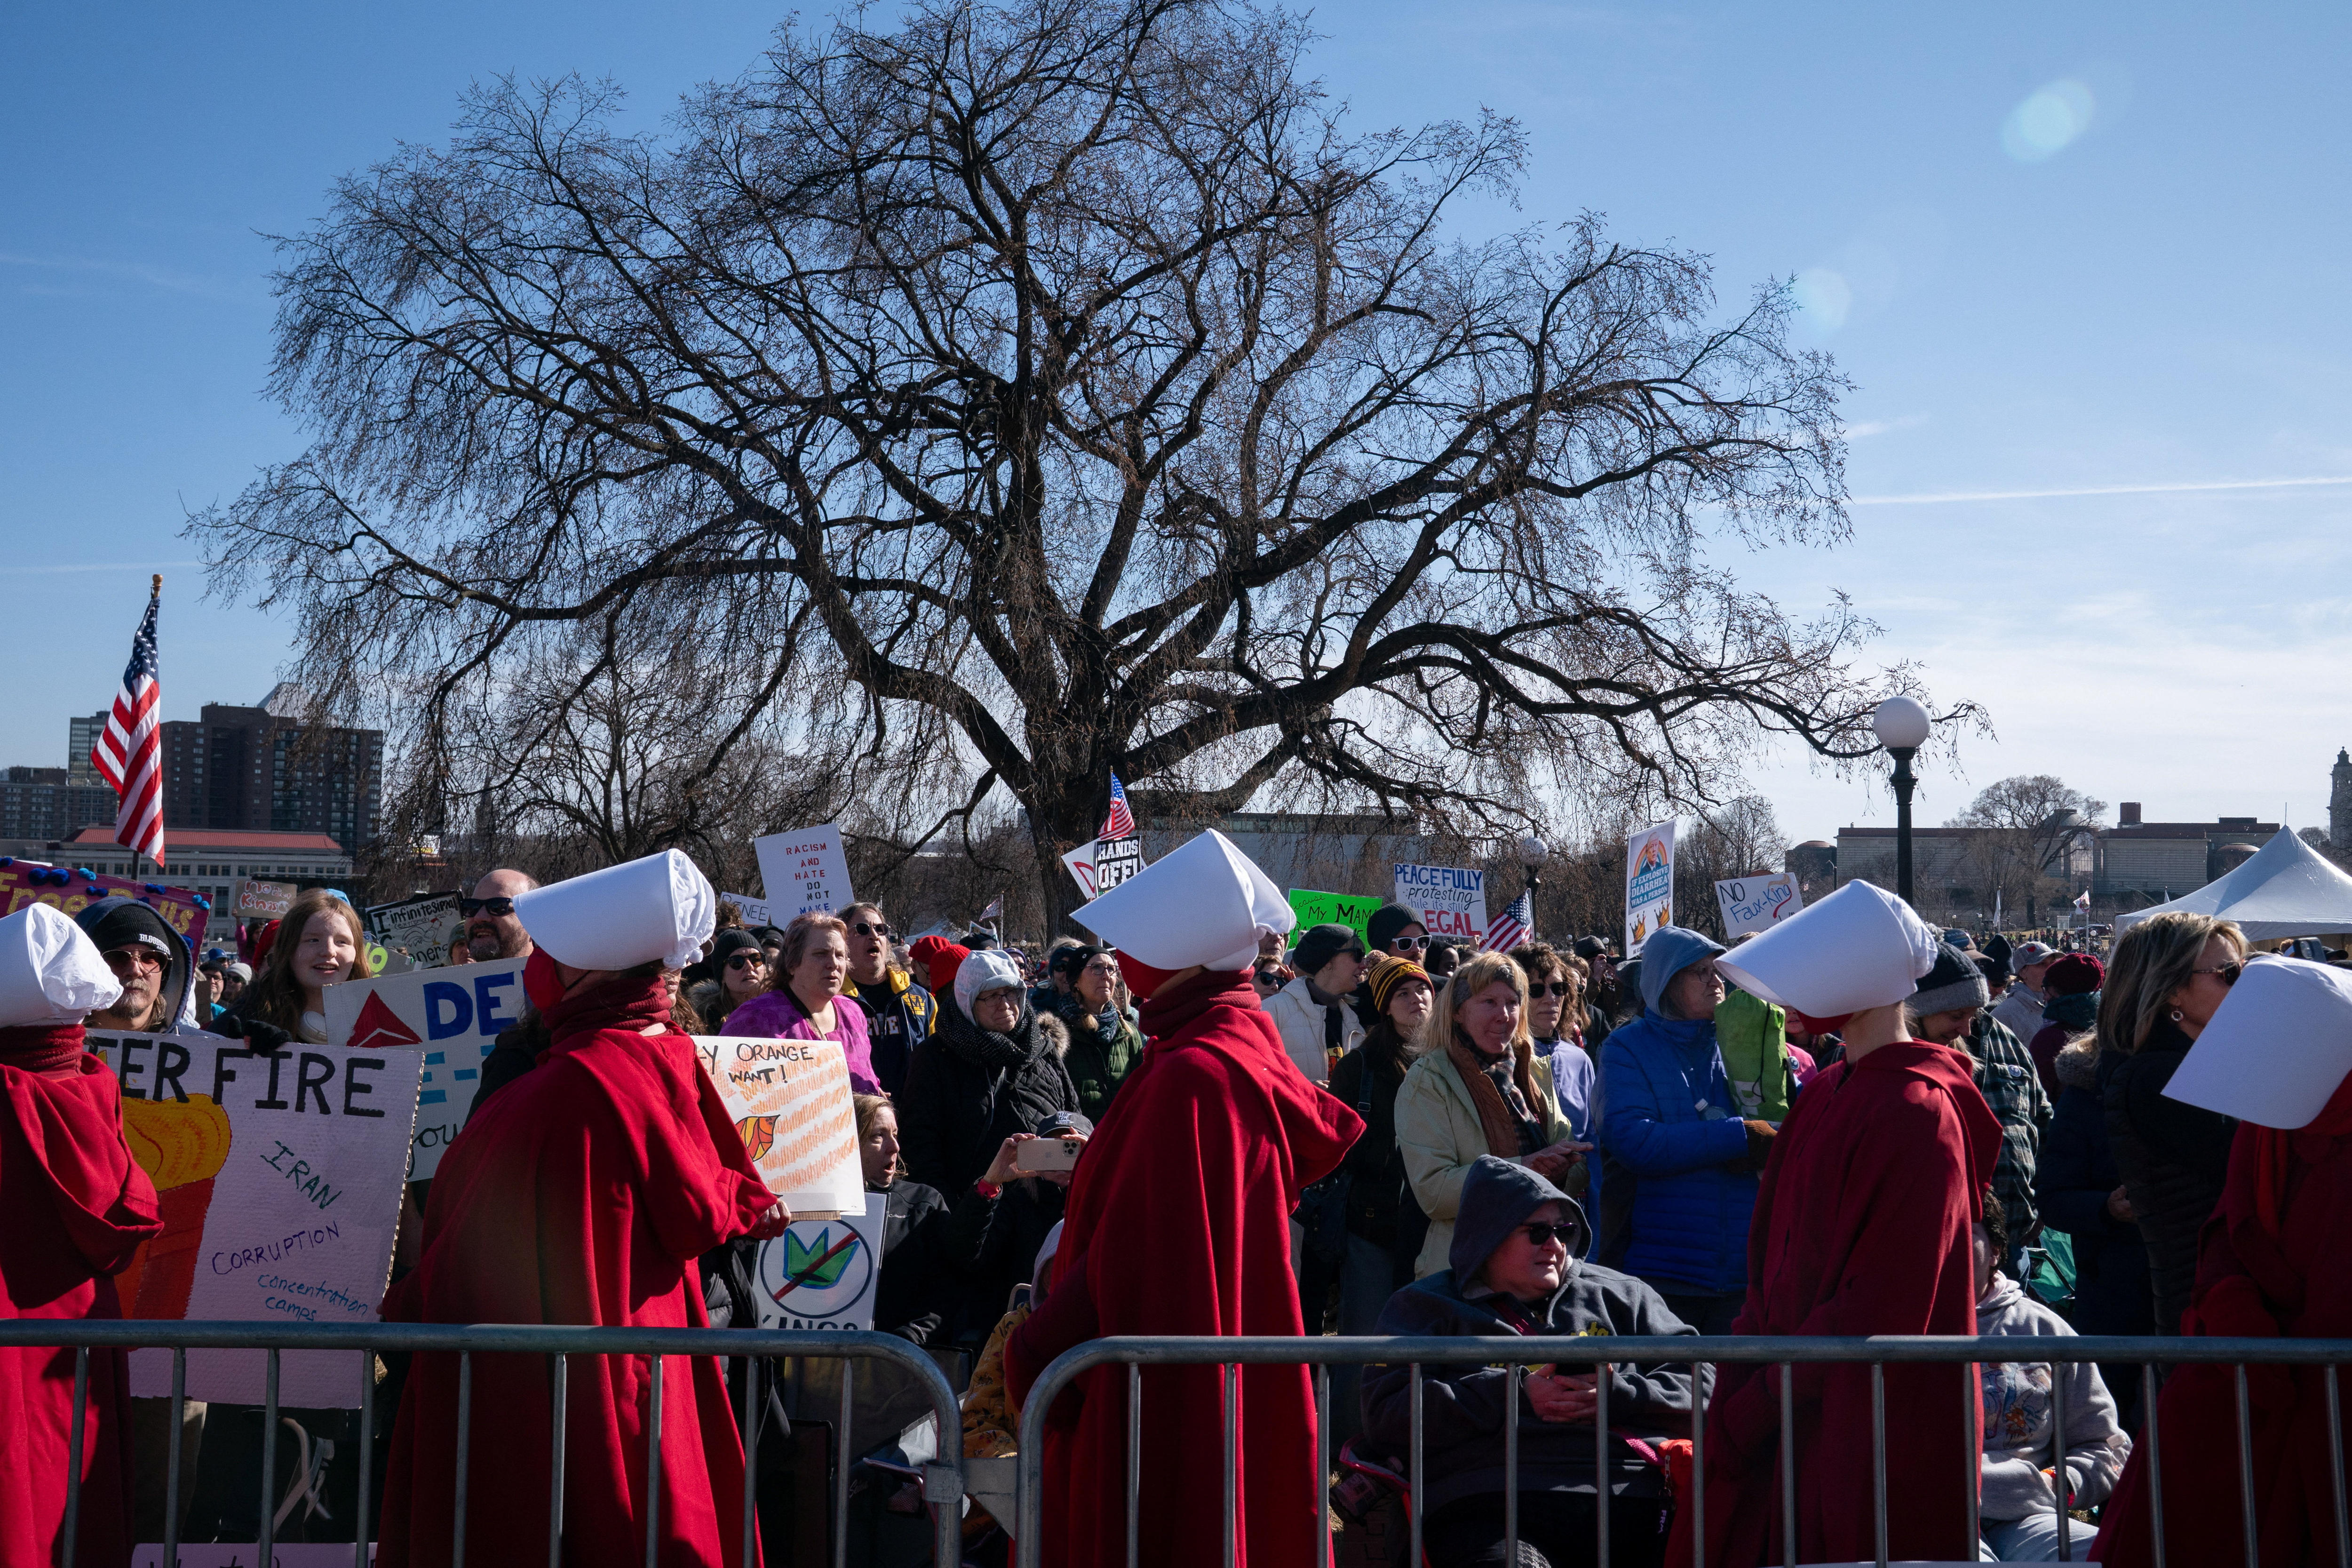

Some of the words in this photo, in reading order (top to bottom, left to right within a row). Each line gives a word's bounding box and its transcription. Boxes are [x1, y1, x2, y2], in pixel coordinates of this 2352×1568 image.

[786, 843, 827, 855] RACISM
[1097, 839, 1138, 860] HANDS
[801, 858, 819, 868] AND
[1098, 858, 1138, 889] OFF!
[795, 869, 826, 880] HATE
[807, 881, 821, 890] DO
[1394, 864, 1482, 891] PEACEFULLY
[1631, 878, 1638, 887] IF
[1638, 866, 1669, 884] EXPLOSIVE
[807, 891, 829, 901] NOT
[1631, 875, 1668, 898] DIARRHEA
[1631, 896, 1643, 907] WAS
[1648, 885, 1668, 899] PERSON
[1719, 882, 1745, 904] NO
[800, 903, 830, 915] MAKE
[1408, 886, 1481, 911] protesting
[1408, 898, 1428, 909] hile
[1432, 899, 1443, 910] it's
[1447, 901, 1464, 913] still
[1730, 884, 1792, 923] Faux-King
[389, 897, 459, 924] infinitesimal
[1308, 906, 1327, 921] My
[1335, 903, 1377, 924] MAM
[1424, 910, 1482, 936] EGAL
[423, 970, 528, 1041] DE
[736, 1043, 814, 1062] ORANGE
[212, 1048, 385, 1118] FIRE
[728, 1065, 788, 1084] WANT!
[260, 1140, 342, 1210] IRAN
[212, 1221, 340, 1276] CORRUPTION
[258, 1274, 368, 1316] concentration
[266, 1297, 318, 1321] camps
